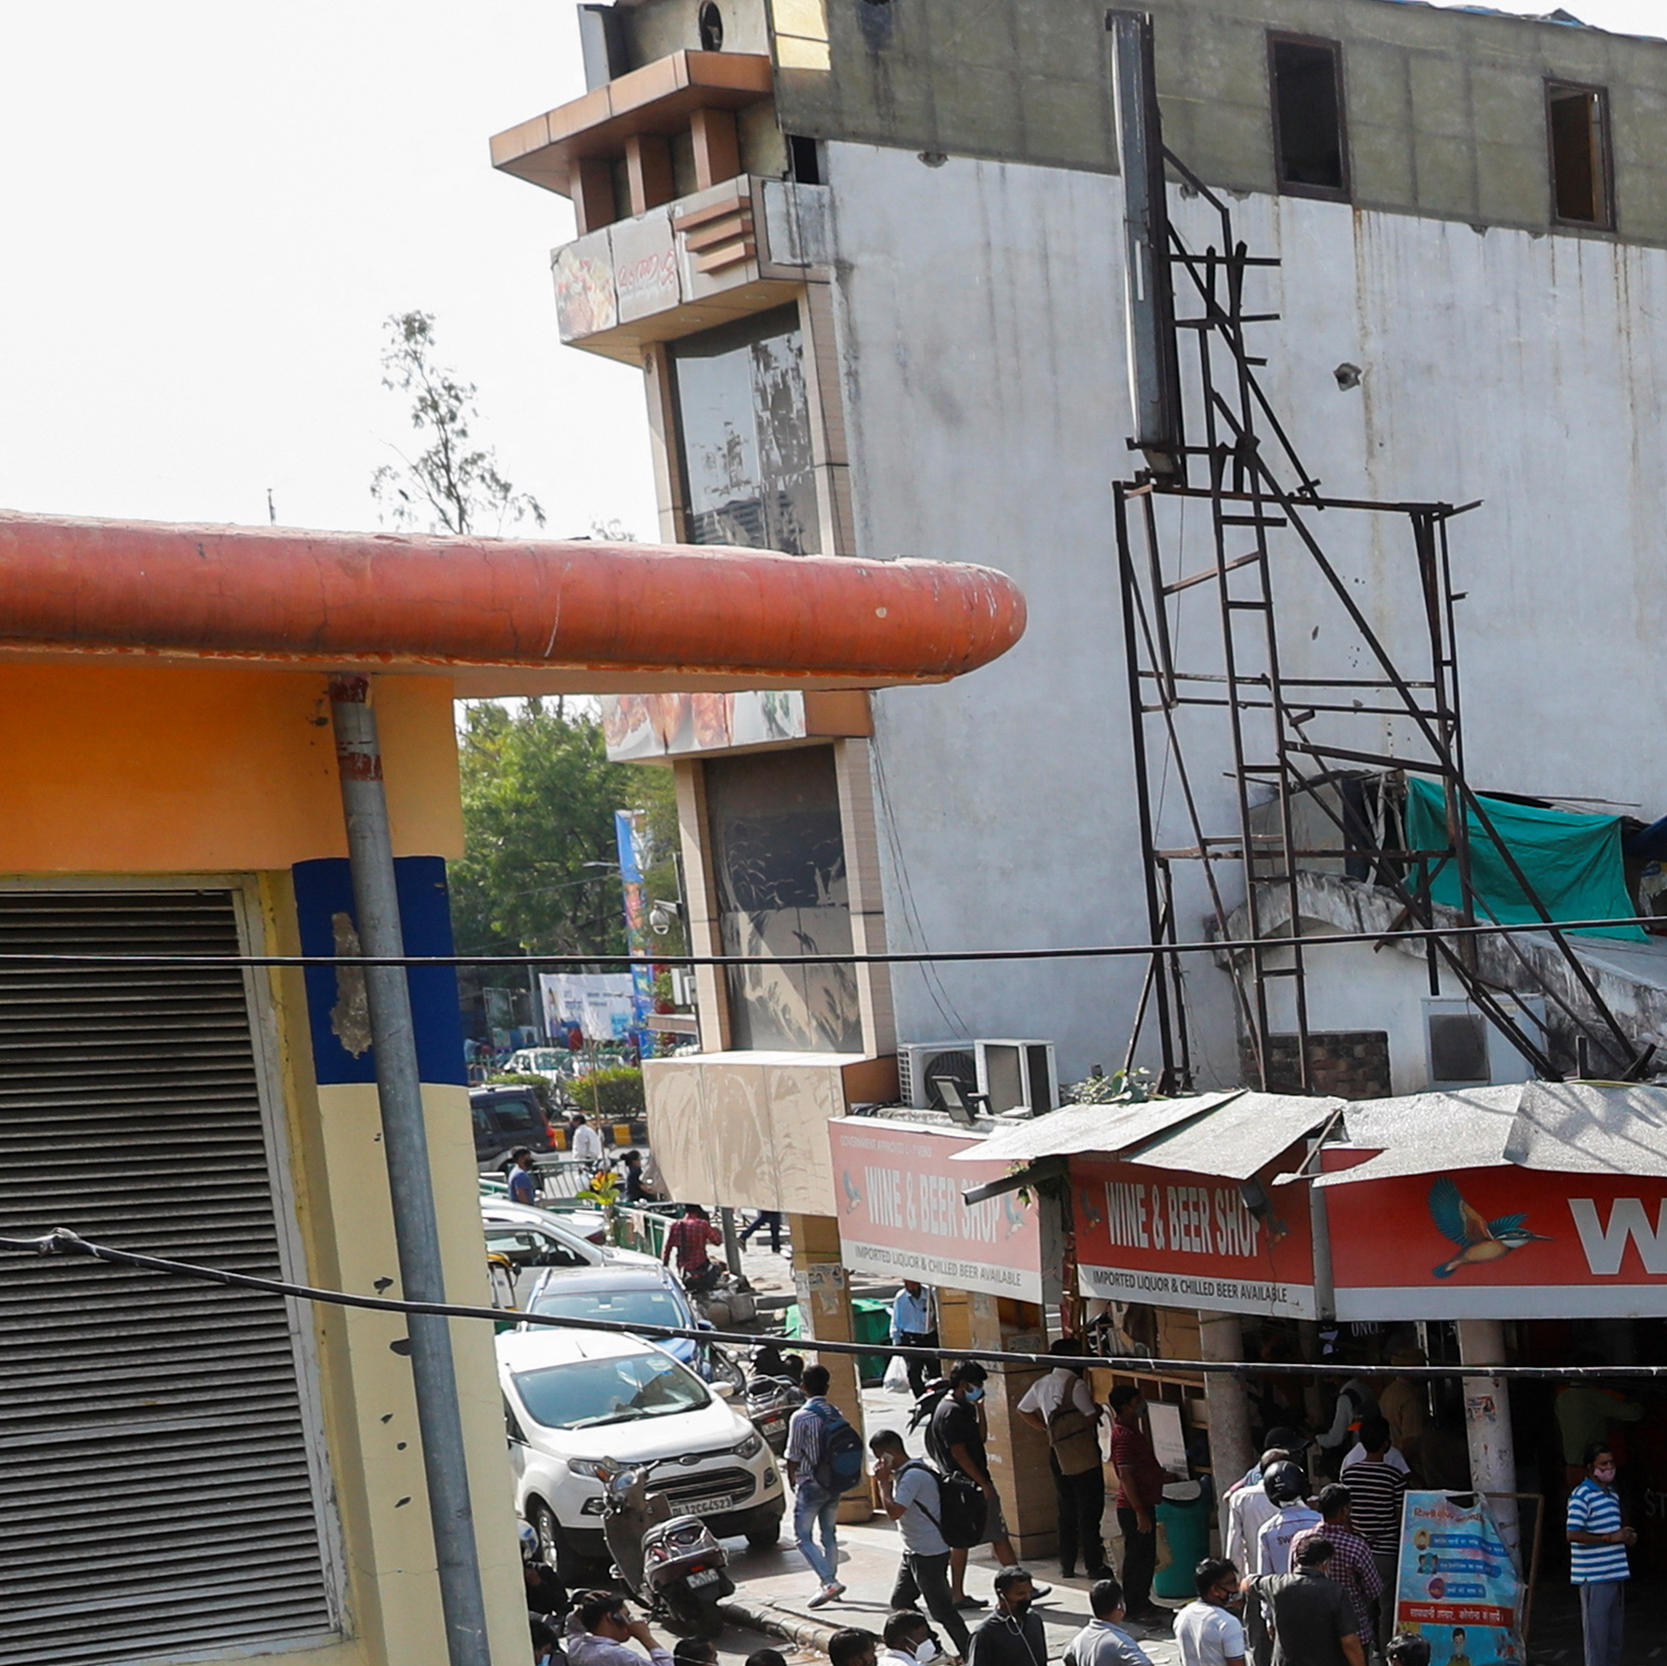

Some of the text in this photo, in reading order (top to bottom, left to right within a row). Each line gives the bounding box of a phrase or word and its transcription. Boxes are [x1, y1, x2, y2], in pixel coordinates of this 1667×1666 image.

[864, 1166, 999, 1243] WINE & BEER SHOP
[1105, 1181, 1261, 1257] WINE & BEER SHOP
[855, 1246, 891, 1264] IMPORTED
[892, 1252, 921, 1270] LIQUOR
[928, 1261, 958, 1276] CHILLED
[959, 1265, 979, 1280] BEER
[980, 1268, 1022, 1287] AVAILABLE
[1093, 1271, 1289, 1304] IMPORTED LIQUOR & CHILLED BEER AVAILABLE
